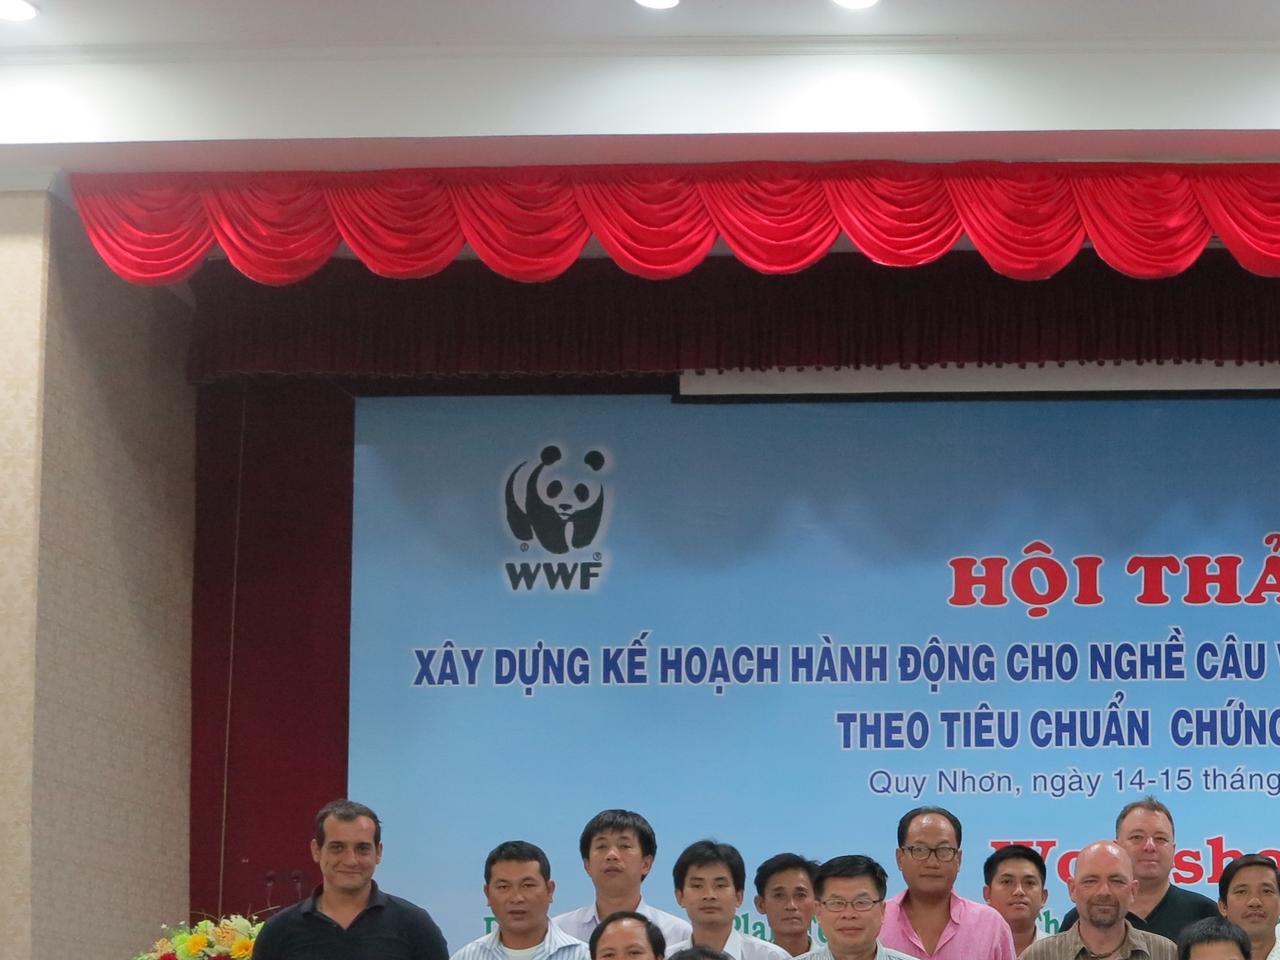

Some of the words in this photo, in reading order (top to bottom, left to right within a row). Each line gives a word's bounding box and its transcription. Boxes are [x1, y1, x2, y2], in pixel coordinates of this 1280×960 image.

[505, 562, 602, 590] WWF
[948, 541, 1104, 618] HỘI
[413, 640, 484, 686] XÂY
[494, 640, 590, 696] DỰNG
[602, 631, 649, 684] KẾ
[659, 646, 779, 695] HOẠCH
[791, 635, 888, 682] HÀNH
[898, 636, 996, 693] ĐỘNG
[1006, 643, 1078, 681] CHO
[1089, 627, 1186, 680] NGHỀ
[1196, 634, 1266, 680] CÂU
[836, 711, 929, 749] THEO
[940, 703, 1020, 748] TIÊU
[1030, 690, 1150, 747] CHUẨN
[869, 770, 928, 798] Quy
[938, 770, 1022, 795] Nhơn,
[1032, 768, 1101, 797] ngày
[1113, 768, 1192, 790] 14-15
